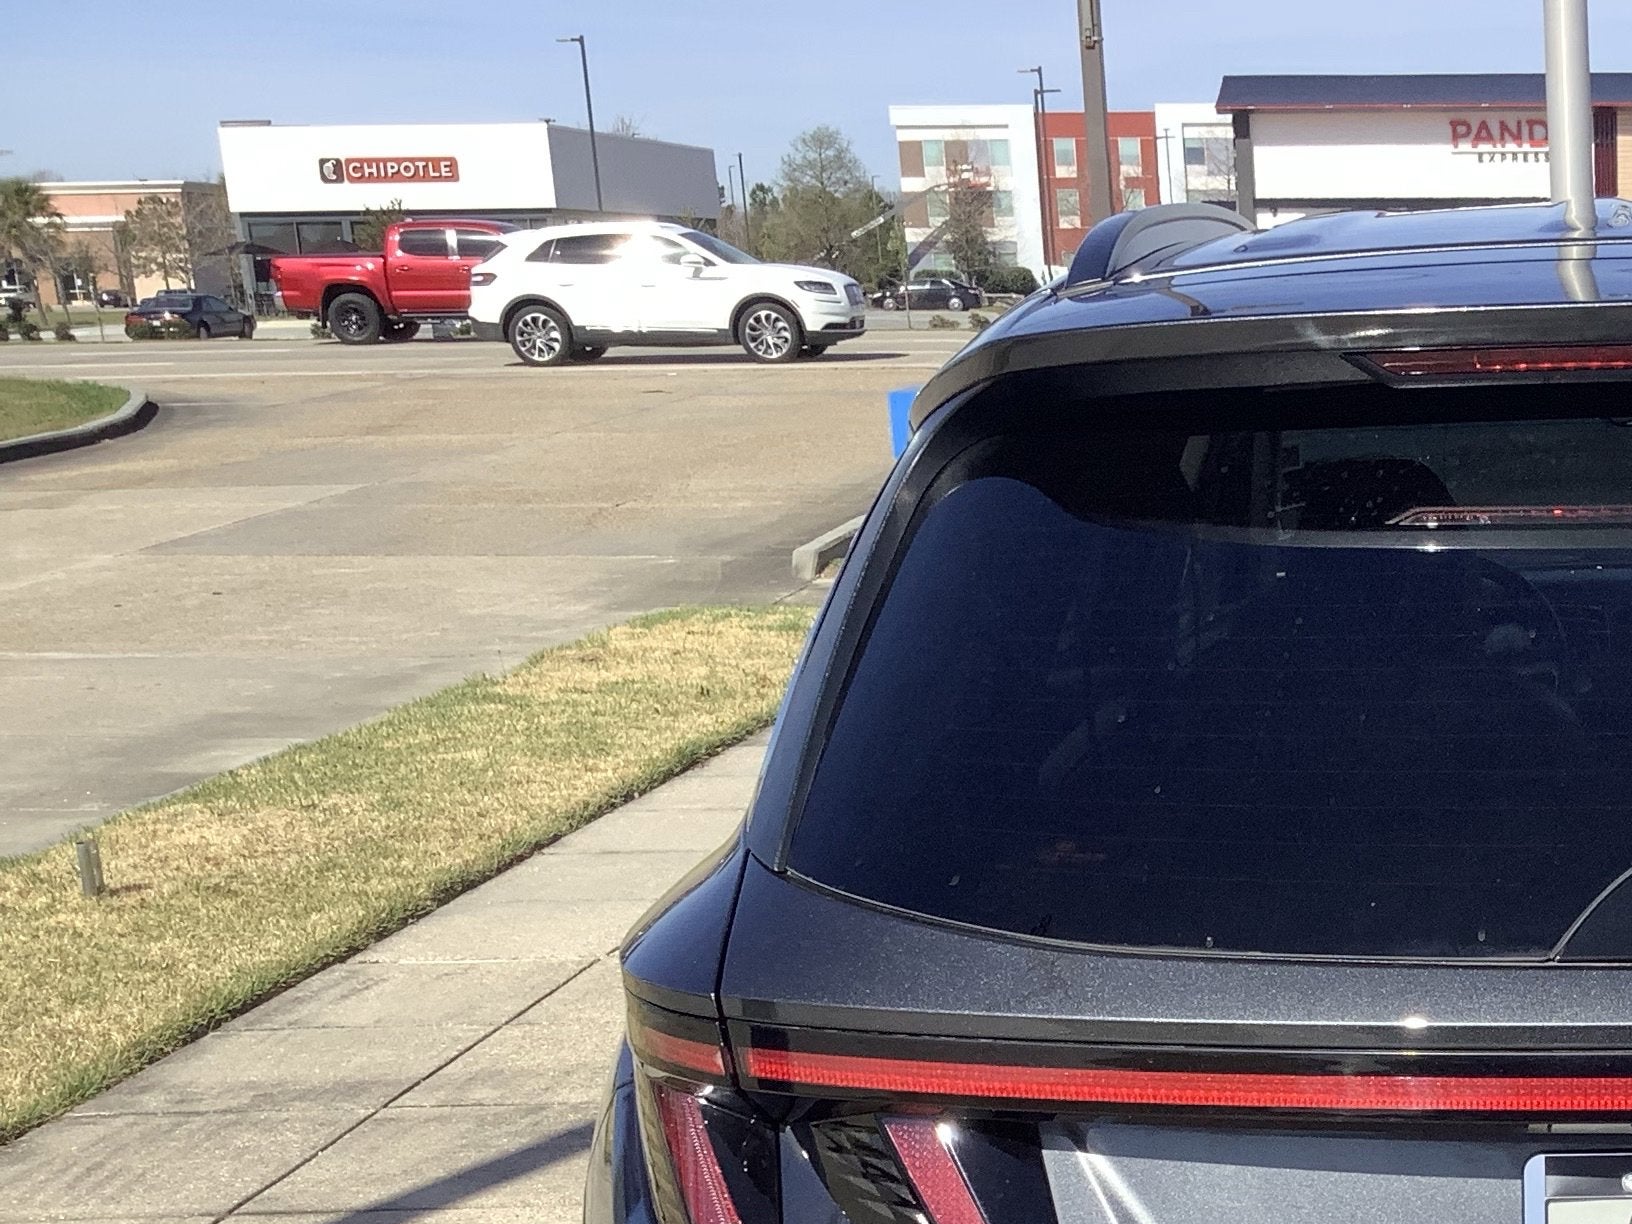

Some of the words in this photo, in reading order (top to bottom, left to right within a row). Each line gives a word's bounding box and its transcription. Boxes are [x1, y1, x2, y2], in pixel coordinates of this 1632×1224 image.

[1449, 119, 1549, 149] PAND
[1477, 152, 1551, 163] EXPRESS
[348, 161, 454, 178] CHIPOTLE
